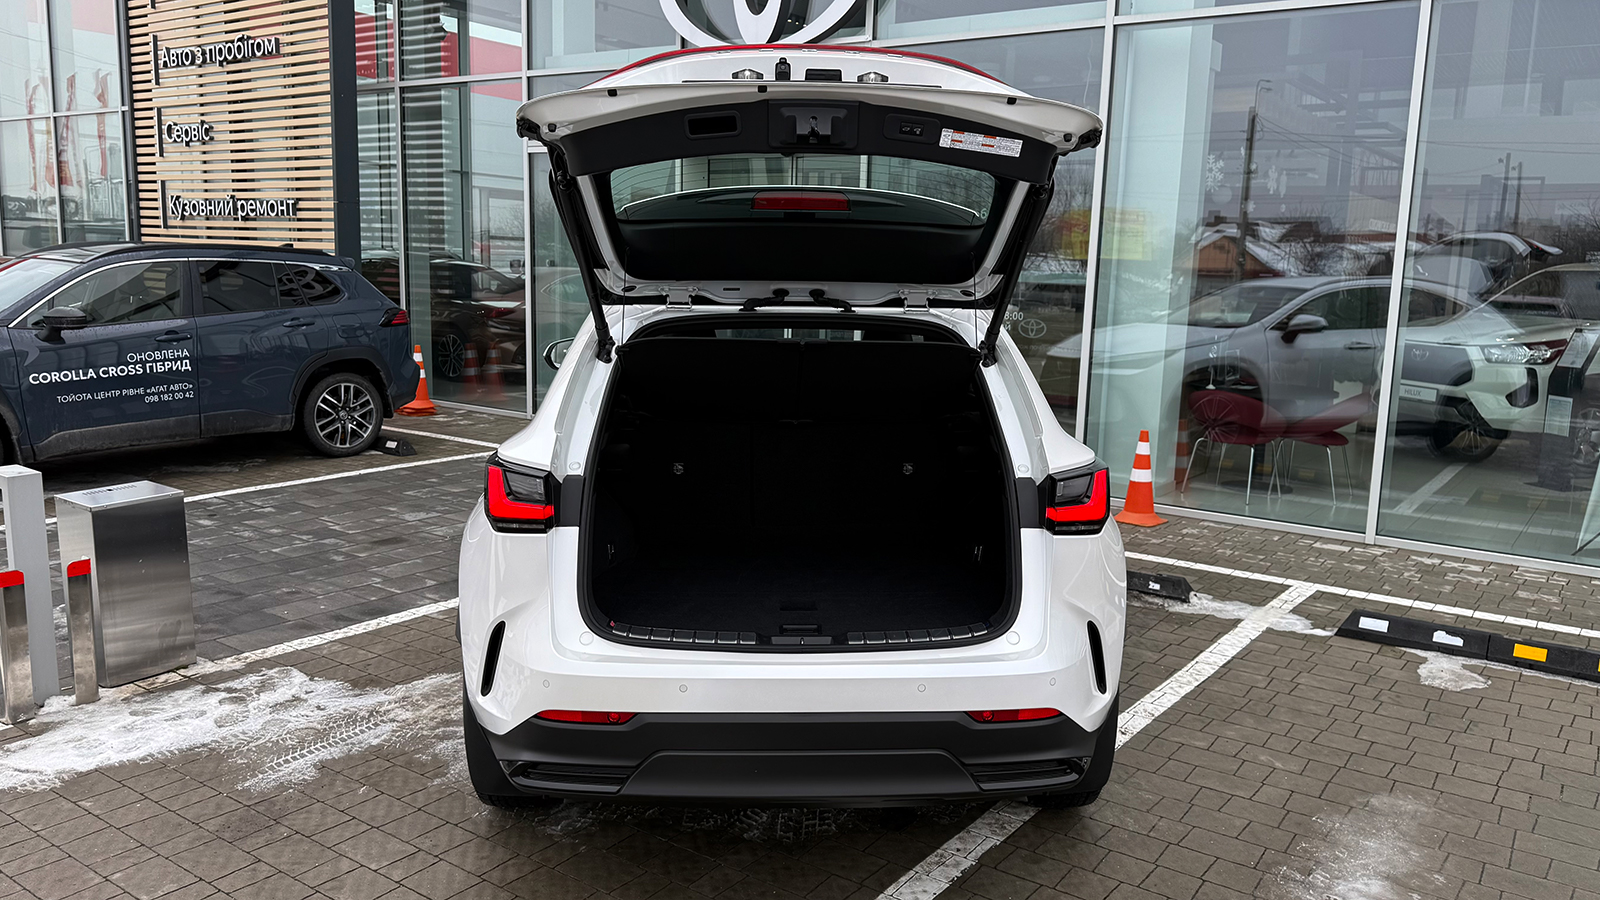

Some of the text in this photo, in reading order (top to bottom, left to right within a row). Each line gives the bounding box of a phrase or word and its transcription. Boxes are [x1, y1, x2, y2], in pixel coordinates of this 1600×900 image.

[161, 34, 278, 68] Авто з пробігом
[165, 120, 212, 146] Сервіс
[169, 194, 297, 222] Кузовний ремонт
[127, 348, 190, 362] ОНОВЛЕНА
[29, 359, 192, 385] COROLLA CROSS ГІБРИД
[56, 392, 93, 404] ТОЙОТА
[94, 389, 121, 401] ЦЕНТР
[122, 387, 145, 396] РІВНЕ
[144, 390, 194, 403] 098 182 00 42
